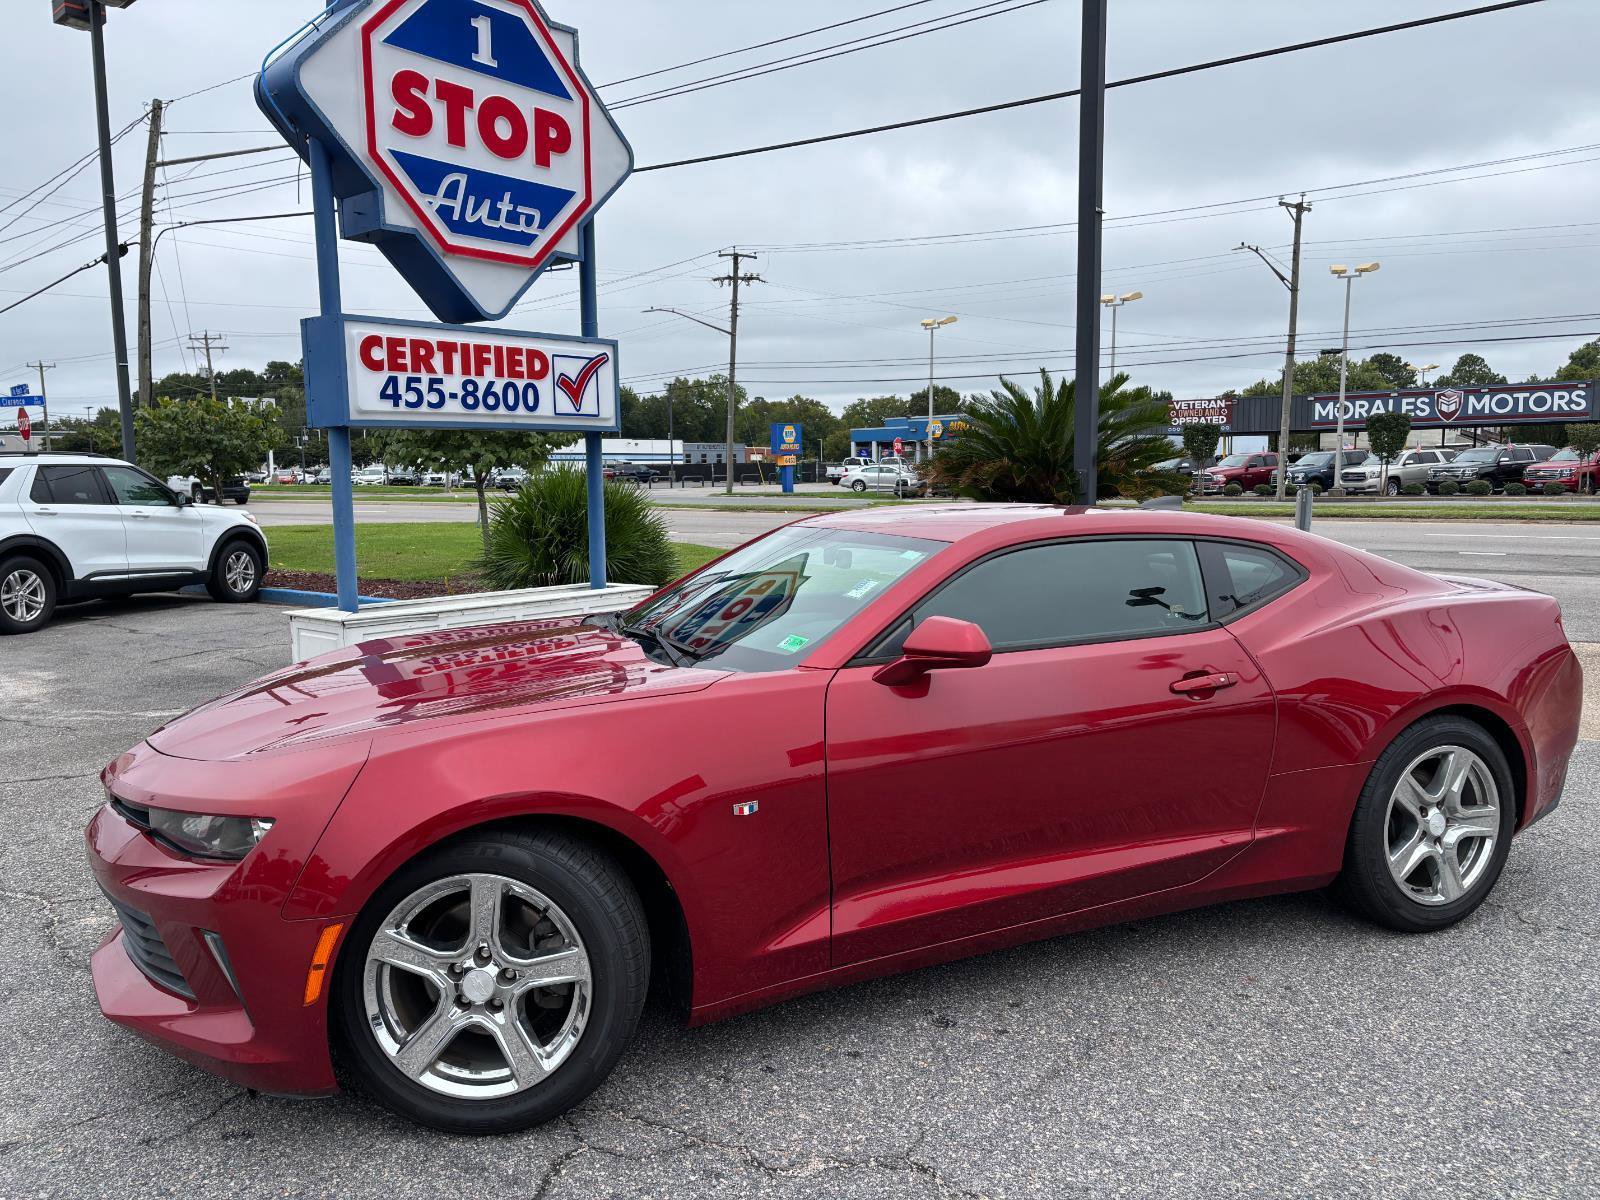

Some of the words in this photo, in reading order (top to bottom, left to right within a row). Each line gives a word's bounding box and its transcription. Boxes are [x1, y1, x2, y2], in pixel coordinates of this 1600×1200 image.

[470, 14, 498, 68] 1
[391, 69, 572, 168] STOP
[424, 173, 542, 233] Auto
[359, 334, 550, 380] CERTIFIED
[379, 375, 540, 413] 455-8600
[1173, 399, 1225, 410] VETERAN
[1178, 409, 1203, 418] OWNED
[1204, 408, 1220, 416] AND
[1467, 390, 1587, 414] MOTORS
[1171, 415, 1227, 426] OPERATED
